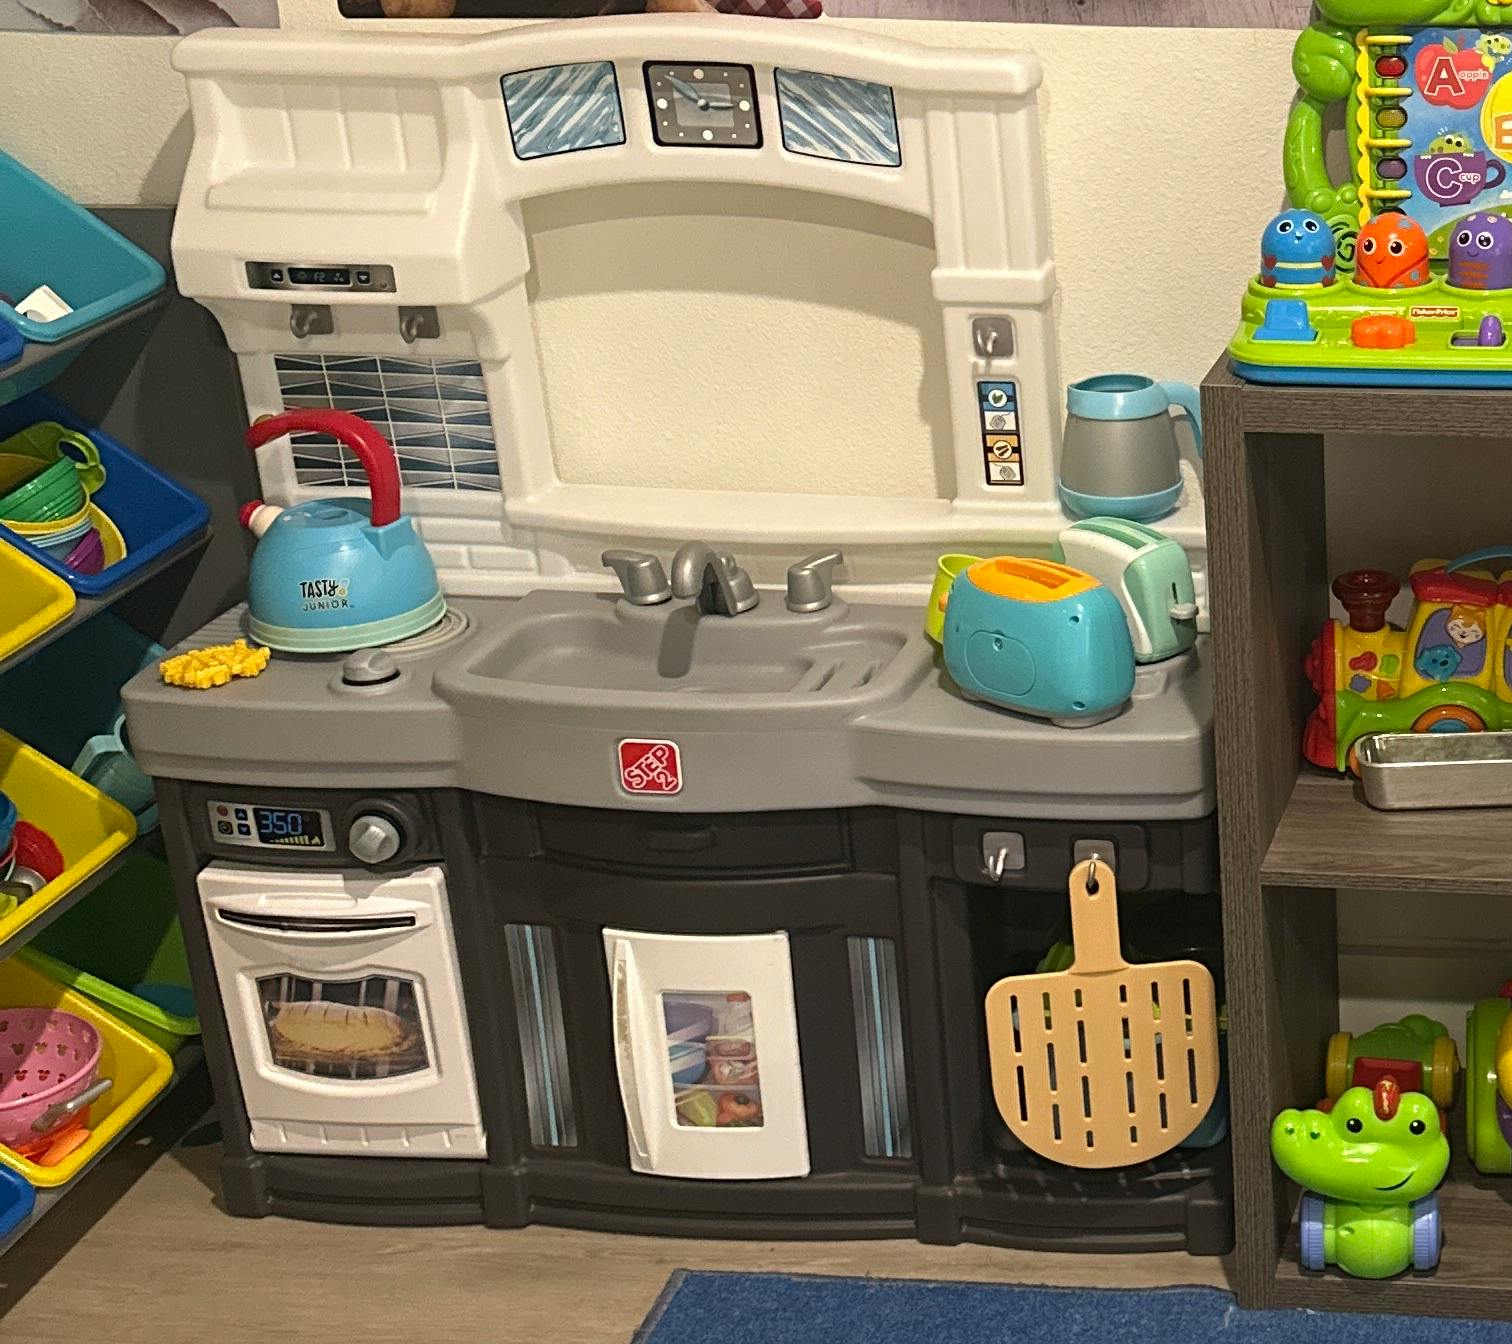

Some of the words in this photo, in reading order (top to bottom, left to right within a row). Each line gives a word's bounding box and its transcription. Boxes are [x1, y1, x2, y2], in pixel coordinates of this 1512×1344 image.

[1424, 57, 1465, 97] A
[1459, 69, 1489, 81] apple
[1425, 157, 1463, 199] C
[1459, 171, 1480, 184] cup
[300, 579, 339, 598] TASTY
[303, 599, 348, 612] JUNIOR
[625, 745, 669, 788] STEP
[654, 769, 677, 790] 2
